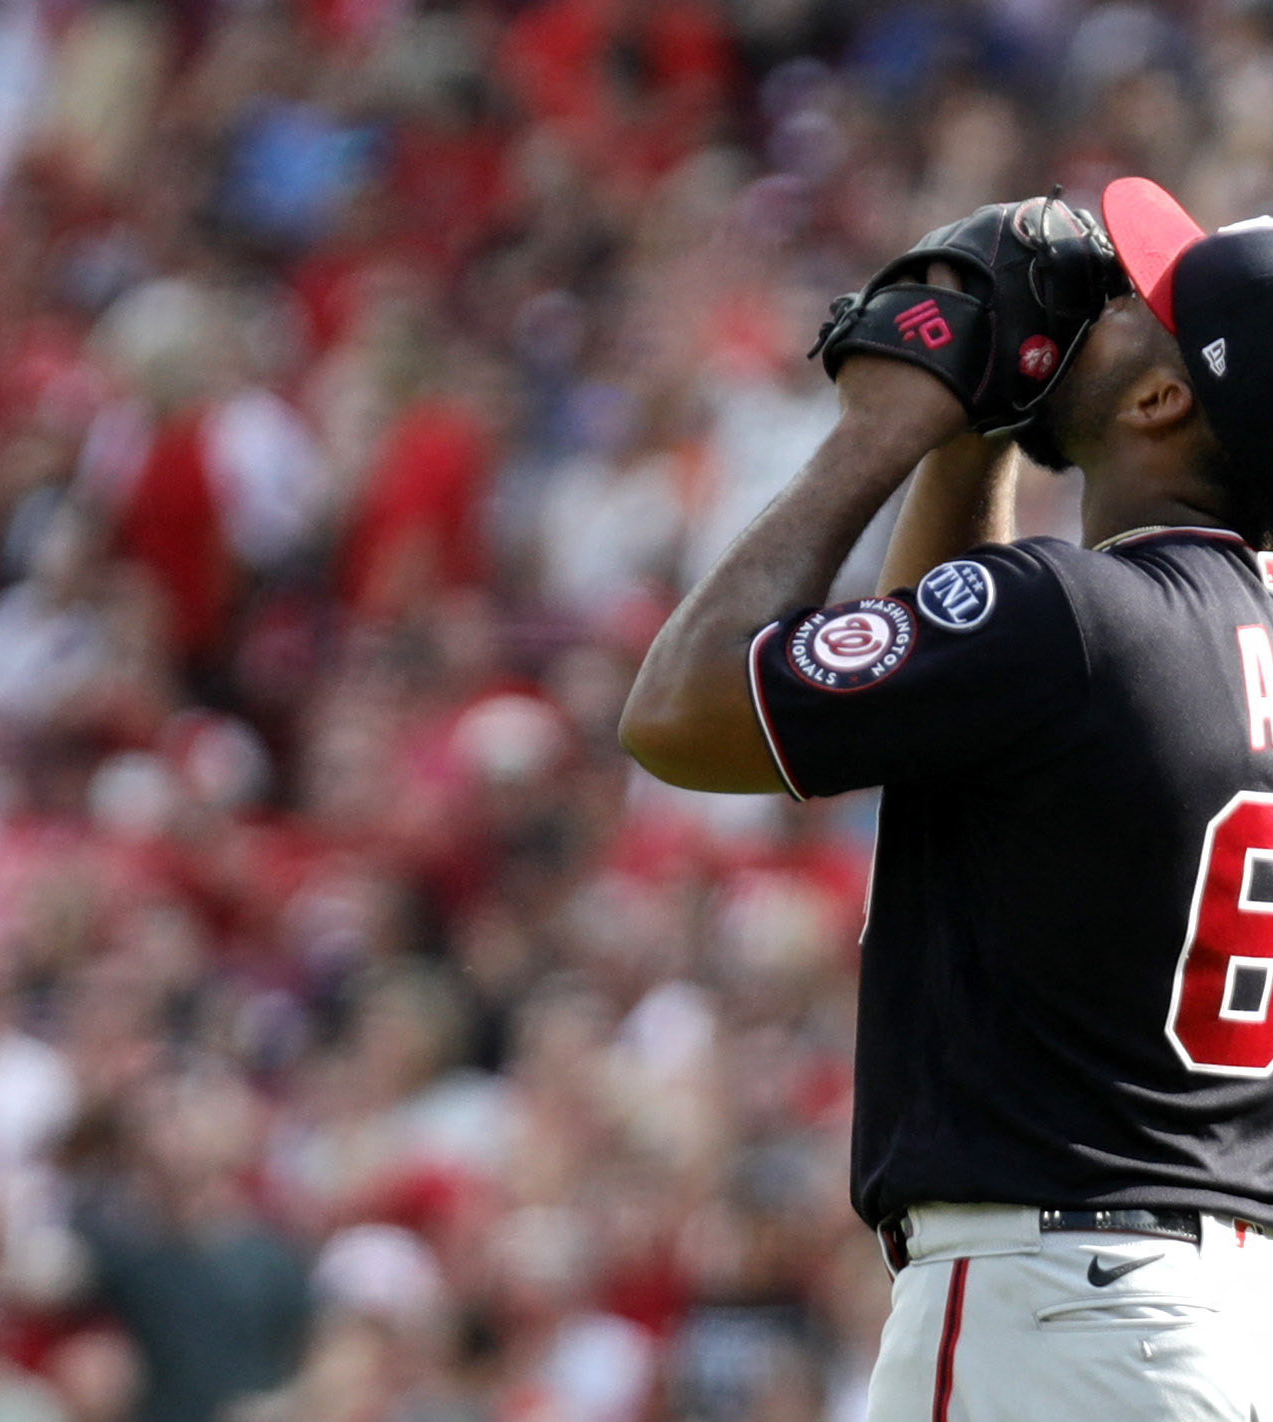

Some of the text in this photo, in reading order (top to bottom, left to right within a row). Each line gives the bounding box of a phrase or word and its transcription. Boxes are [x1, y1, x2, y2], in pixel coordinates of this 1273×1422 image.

[926, 563, 980, 624] TNL
[791, 613, 837, 686] NATIONALS
[859, 598, 913, 678] WASHINGTON
